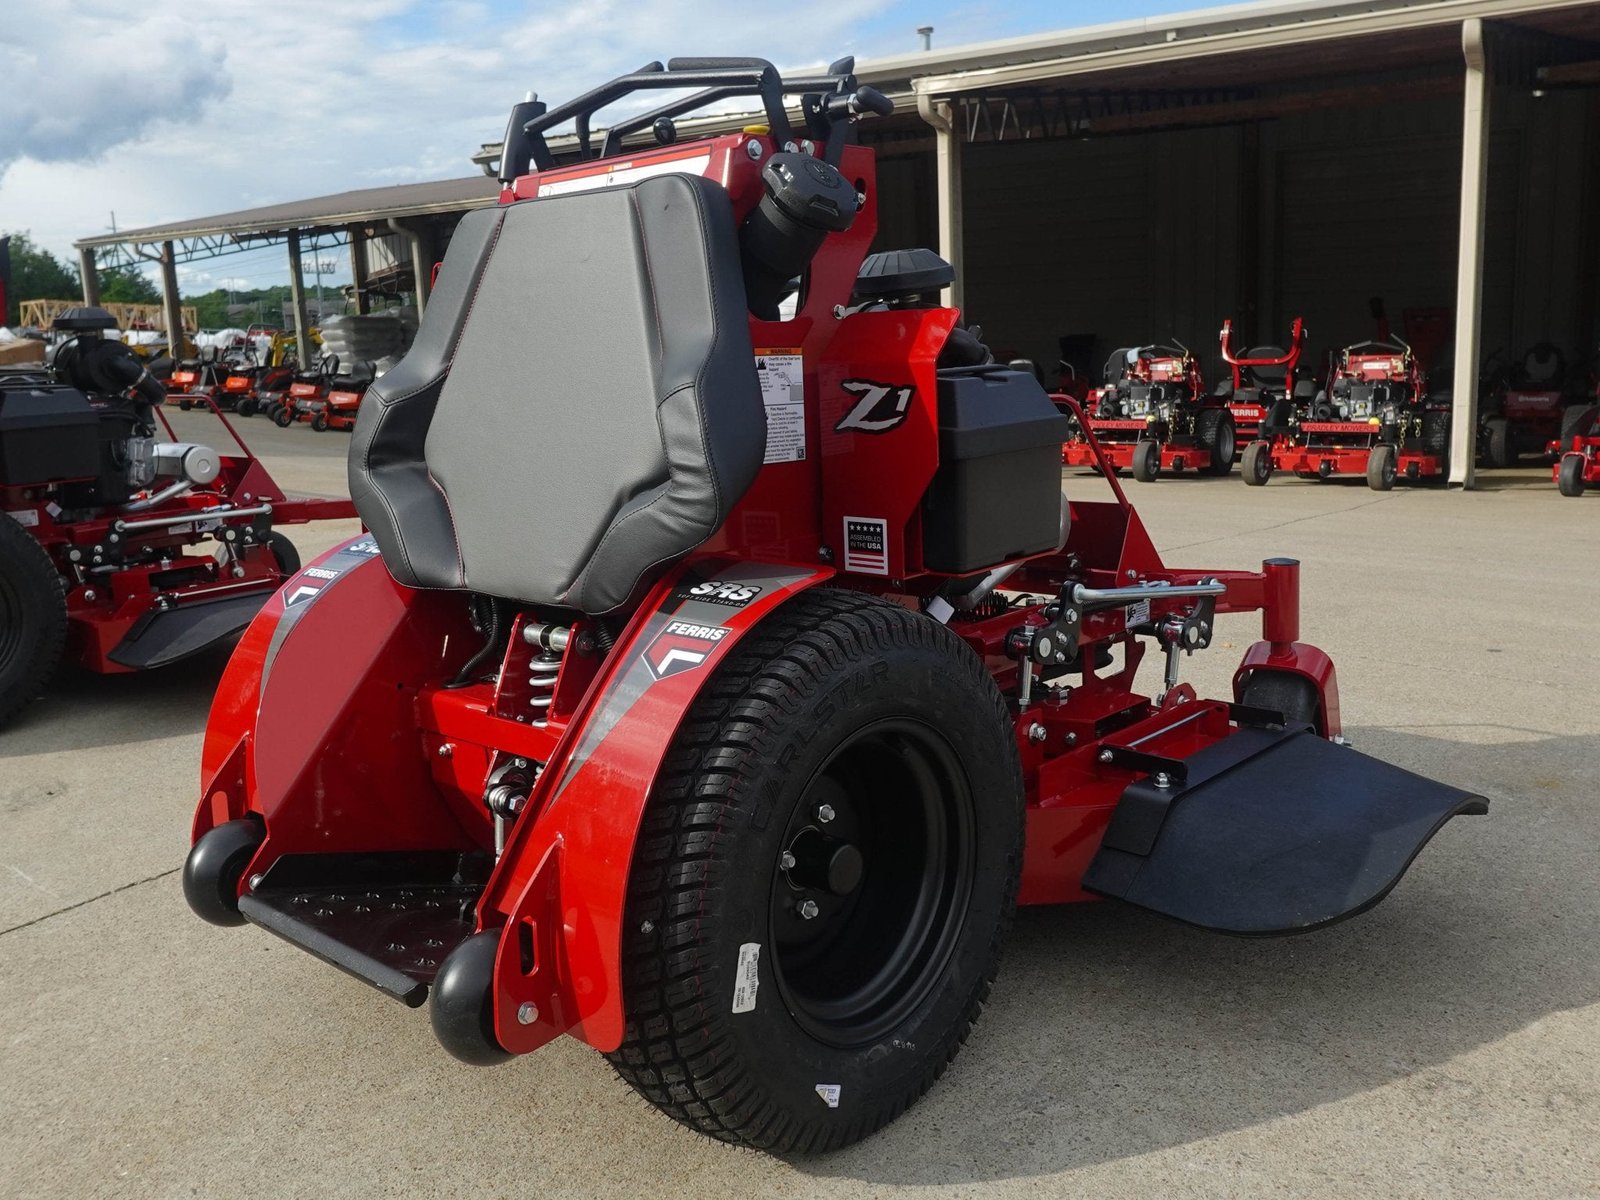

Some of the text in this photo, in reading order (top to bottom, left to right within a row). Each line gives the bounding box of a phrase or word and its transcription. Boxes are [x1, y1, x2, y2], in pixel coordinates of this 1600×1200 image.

[850, 534, 881, 542] ASSEMBLED
[304, 567, 339, 580] FERRIS
[690, 581, 761, 601] SRS
[666, 622, 726, 641] FERRIS
